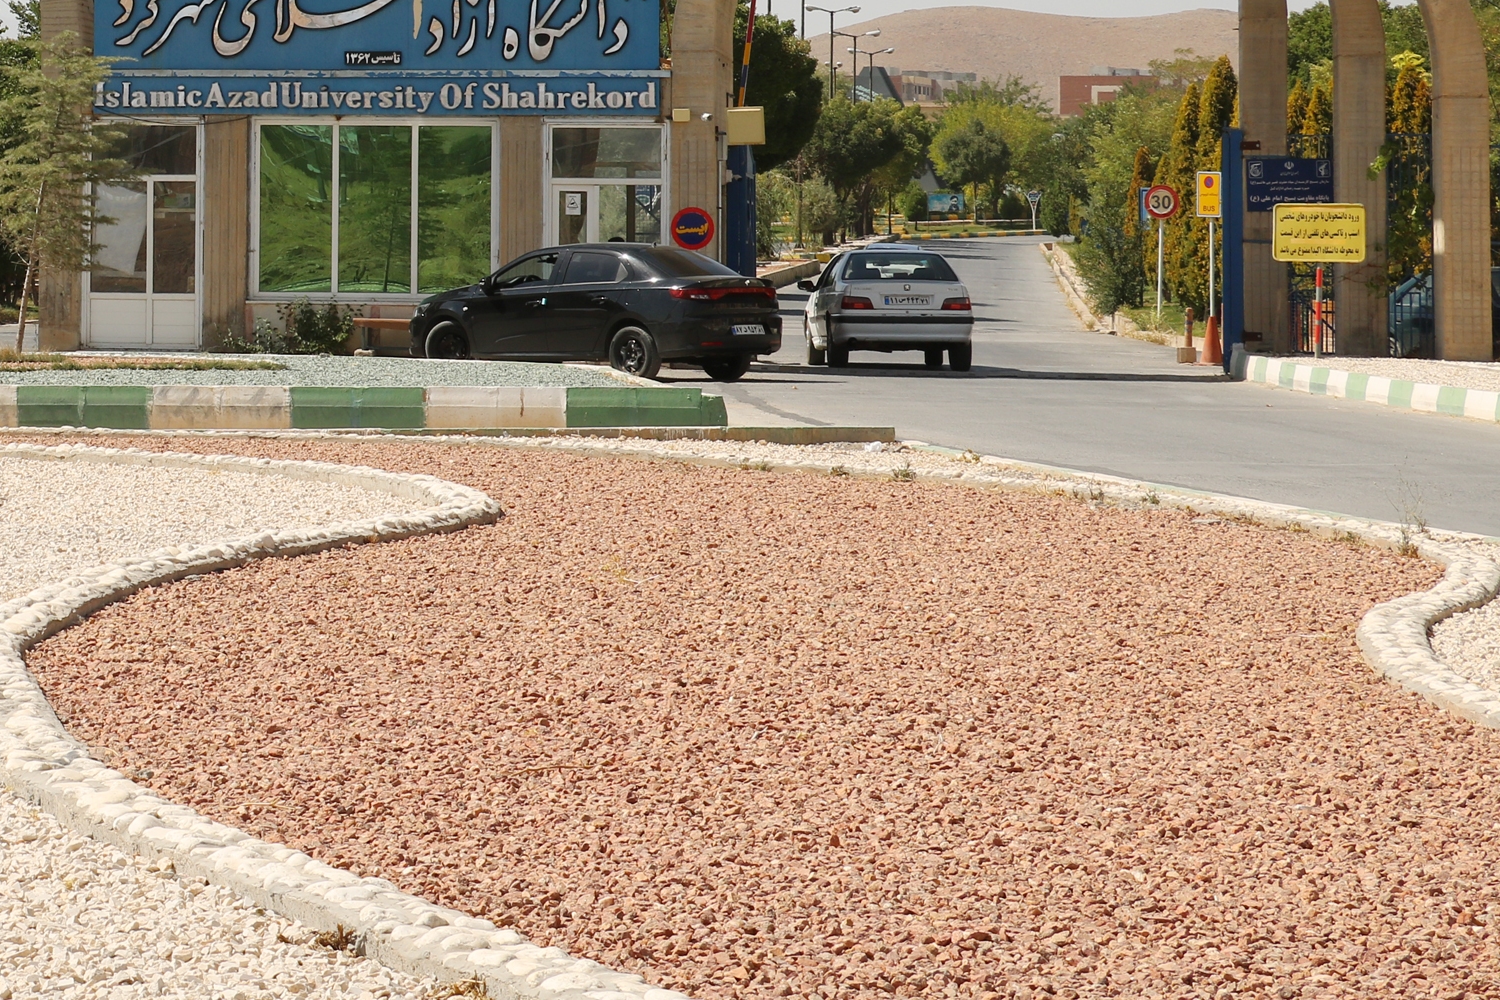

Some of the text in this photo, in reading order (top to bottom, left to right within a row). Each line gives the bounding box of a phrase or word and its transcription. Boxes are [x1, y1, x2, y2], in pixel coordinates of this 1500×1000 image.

[345, 52, 370, 64] ۱۳۶۲
[94, 81, 657, 113] Islamic Azad University Of Shahrekord
[1151, 195, 1172, 209] 30
[675, 222, 709, 236] ایست
